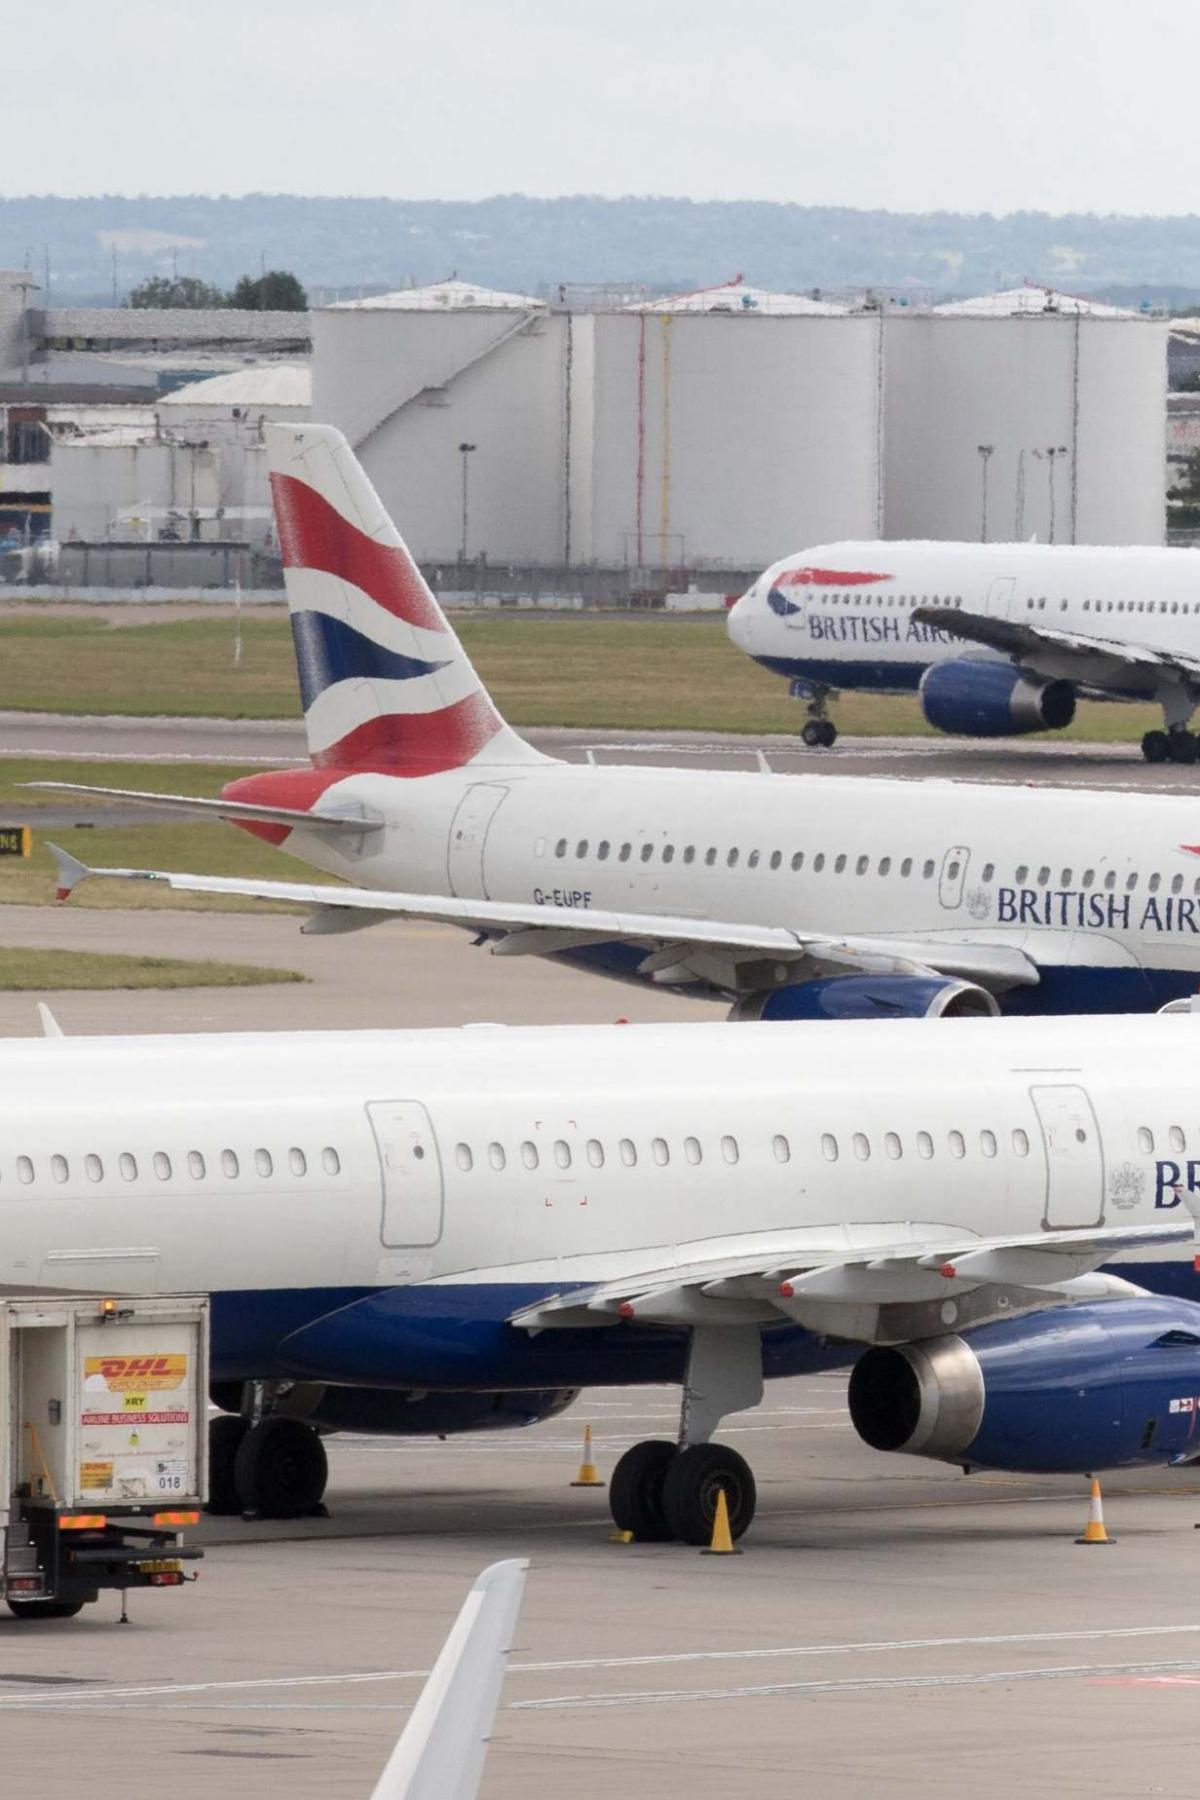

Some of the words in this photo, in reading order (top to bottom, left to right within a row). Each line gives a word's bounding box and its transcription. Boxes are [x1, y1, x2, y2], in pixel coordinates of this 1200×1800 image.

[808, 614, 900, 643] BRITISH
[533, 887, 592, 909] G-EUPF
[998, 887, 1130, 929] BRITISH
[100, 1359, 171, 1377] DHL
[83, 1414, 111, 1424] AIRLINE
[111, 1413, 146, 1423] BUSINESS
[149, 1412, 187, 1422] SOLUTIONS
[159, 1476, 181, 1489] 018
